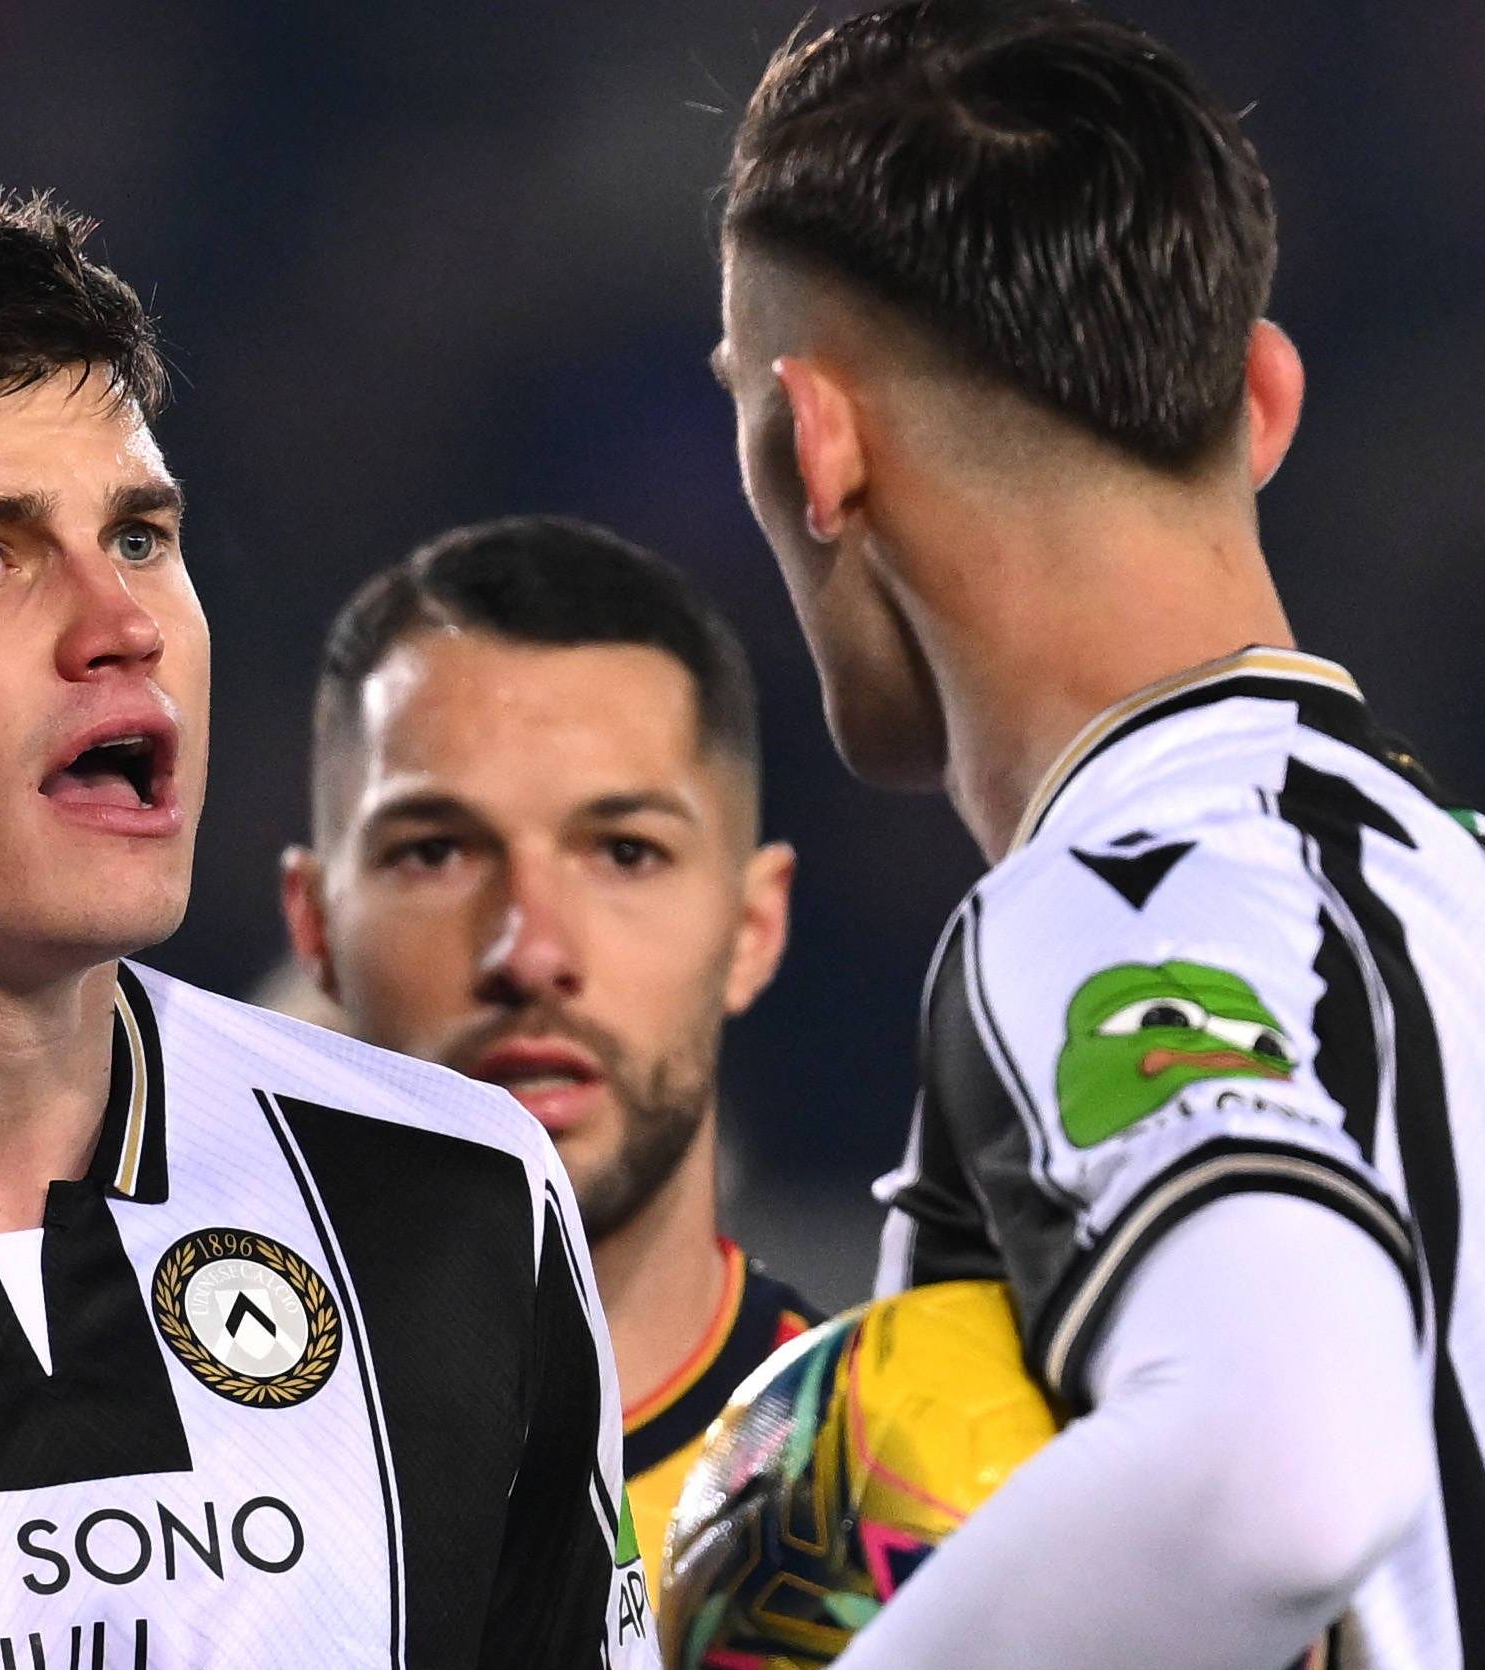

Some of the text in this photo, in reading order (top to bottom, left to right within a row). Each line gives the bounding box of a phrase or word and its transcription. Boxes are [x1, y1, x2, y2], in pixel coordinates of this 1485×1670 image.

[196, 1233, 253, 1259] 1896
[17, 1496, 304, 1595] SONO
[619, 1570, 652, 1646] AP
